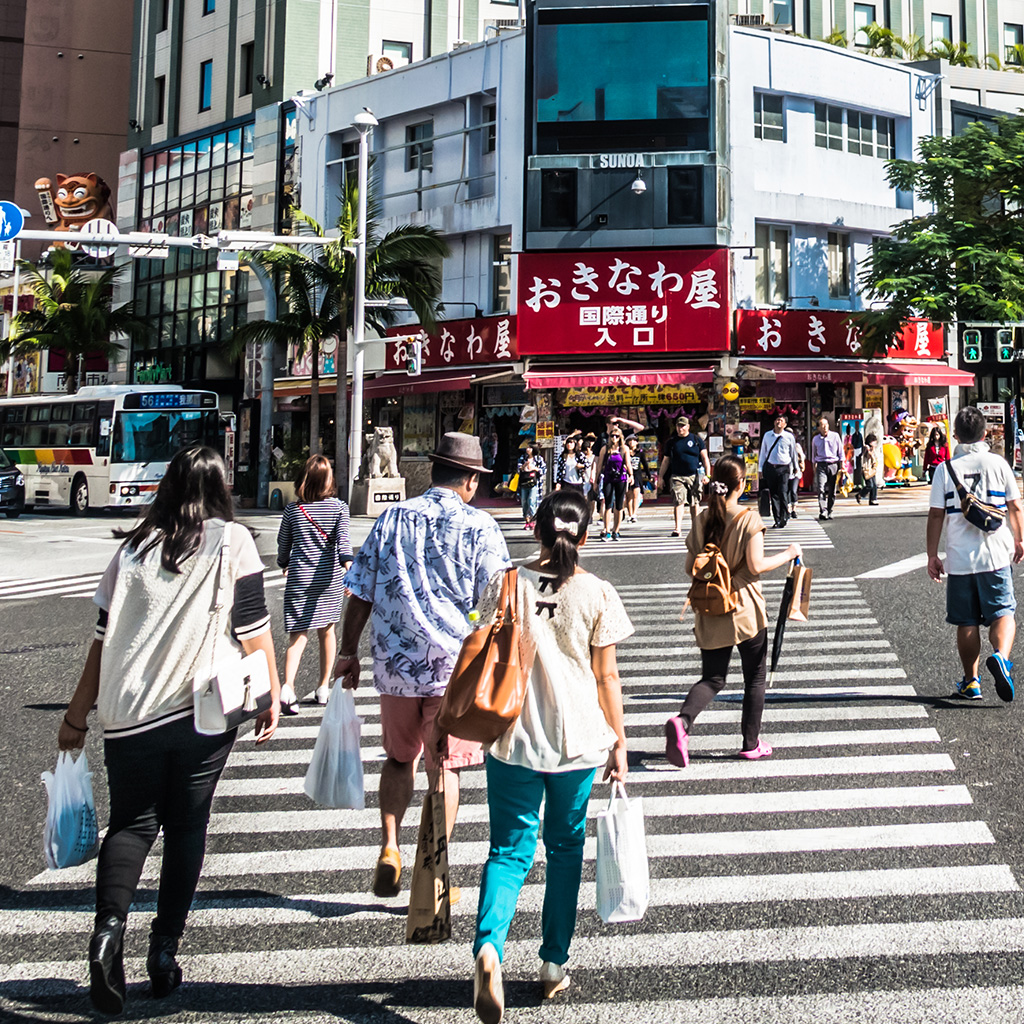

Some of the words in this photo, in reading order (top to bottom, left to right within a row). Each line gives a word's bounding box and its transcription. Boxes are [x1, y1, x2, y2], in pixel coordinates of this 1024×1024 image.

[600, 153, 644, 169] SUNOA
[525, 257, 721, 313] おきなわ屋
[579, 305, 668, 326] 国際通り
[594, 327, 655, 347] 入口
[757, 315, 931, 356] おきな屋
[141, 395, 154, 407] 56
